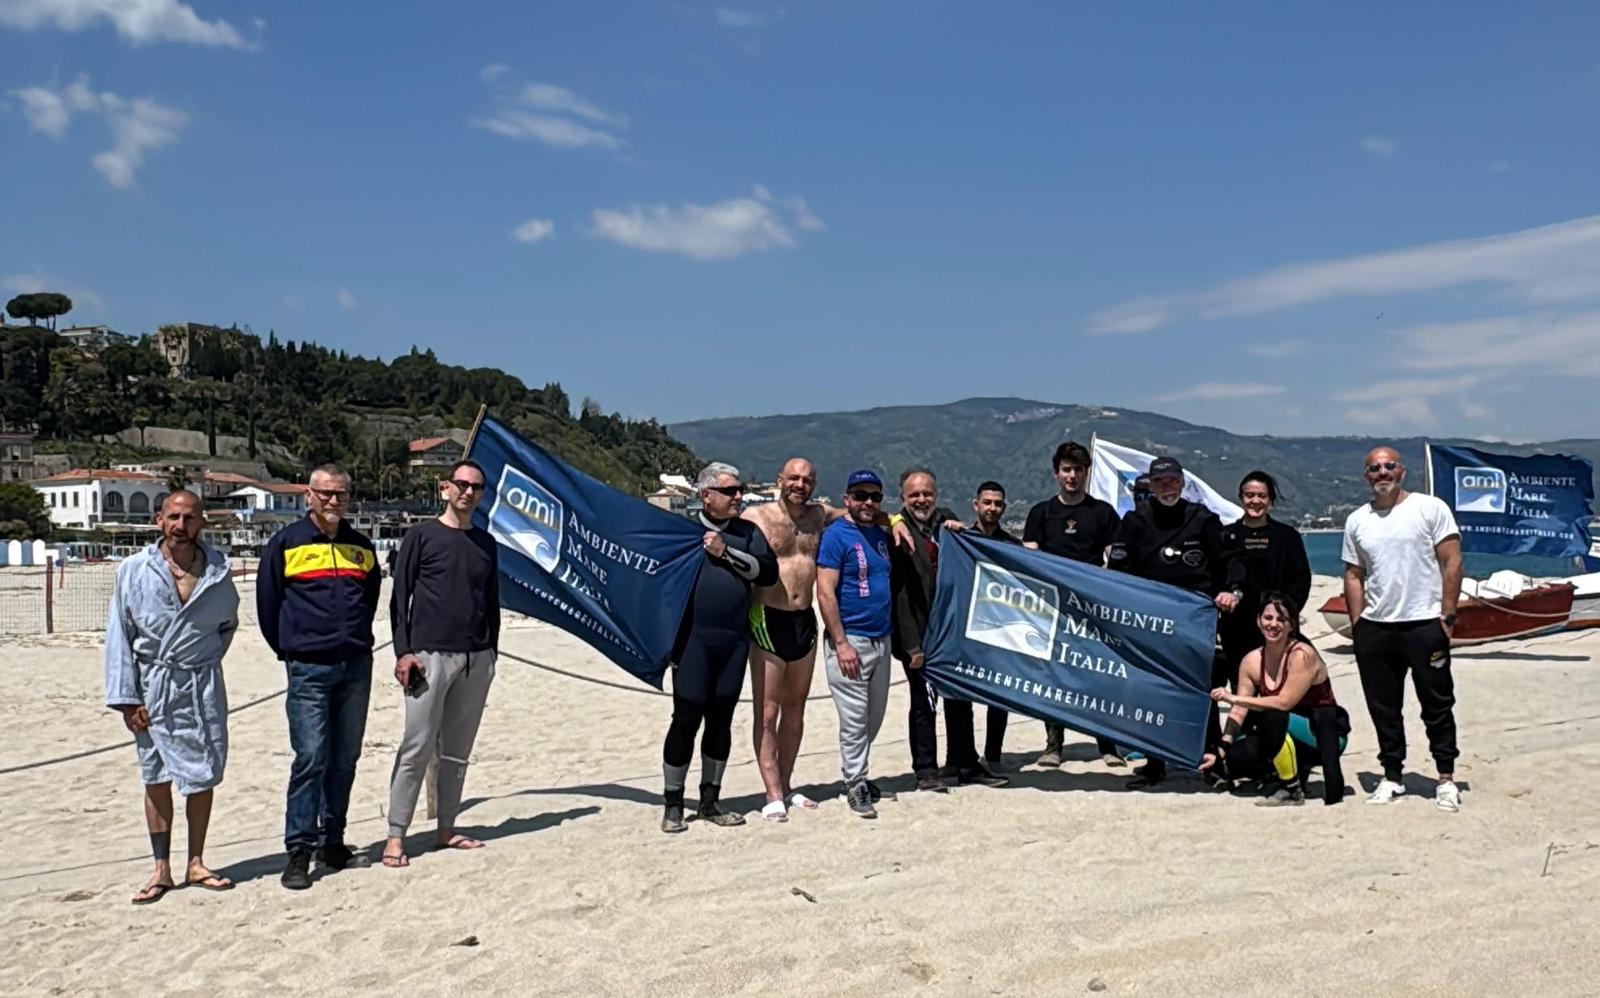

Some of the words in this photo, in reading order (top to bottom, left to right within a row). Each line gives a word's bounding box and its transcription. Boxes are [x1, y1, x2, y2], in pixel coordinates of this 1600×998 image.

[1462, 473, 1499, 488] ami
[1509, 472, 1576, 486] AMBIENTE
[1509, 487, 1547, 502] MARE
[506, 487, 555, 527] ami
[1509, 503, 1549, 519] ITALIA
[567, 535, 608, 586] MARE
[568, 510, 660, 576] AMBIENTE
[986, 581, 1046, 613] ami
[1066, 591, 1174, 635] AMBIENTE
[1063, 613, 1122, 647] MA
[1057, 642, 1128, 679] ITALIA
[955, 661, 1166, 726] AMBIENTEMAREITALIA.ORG
